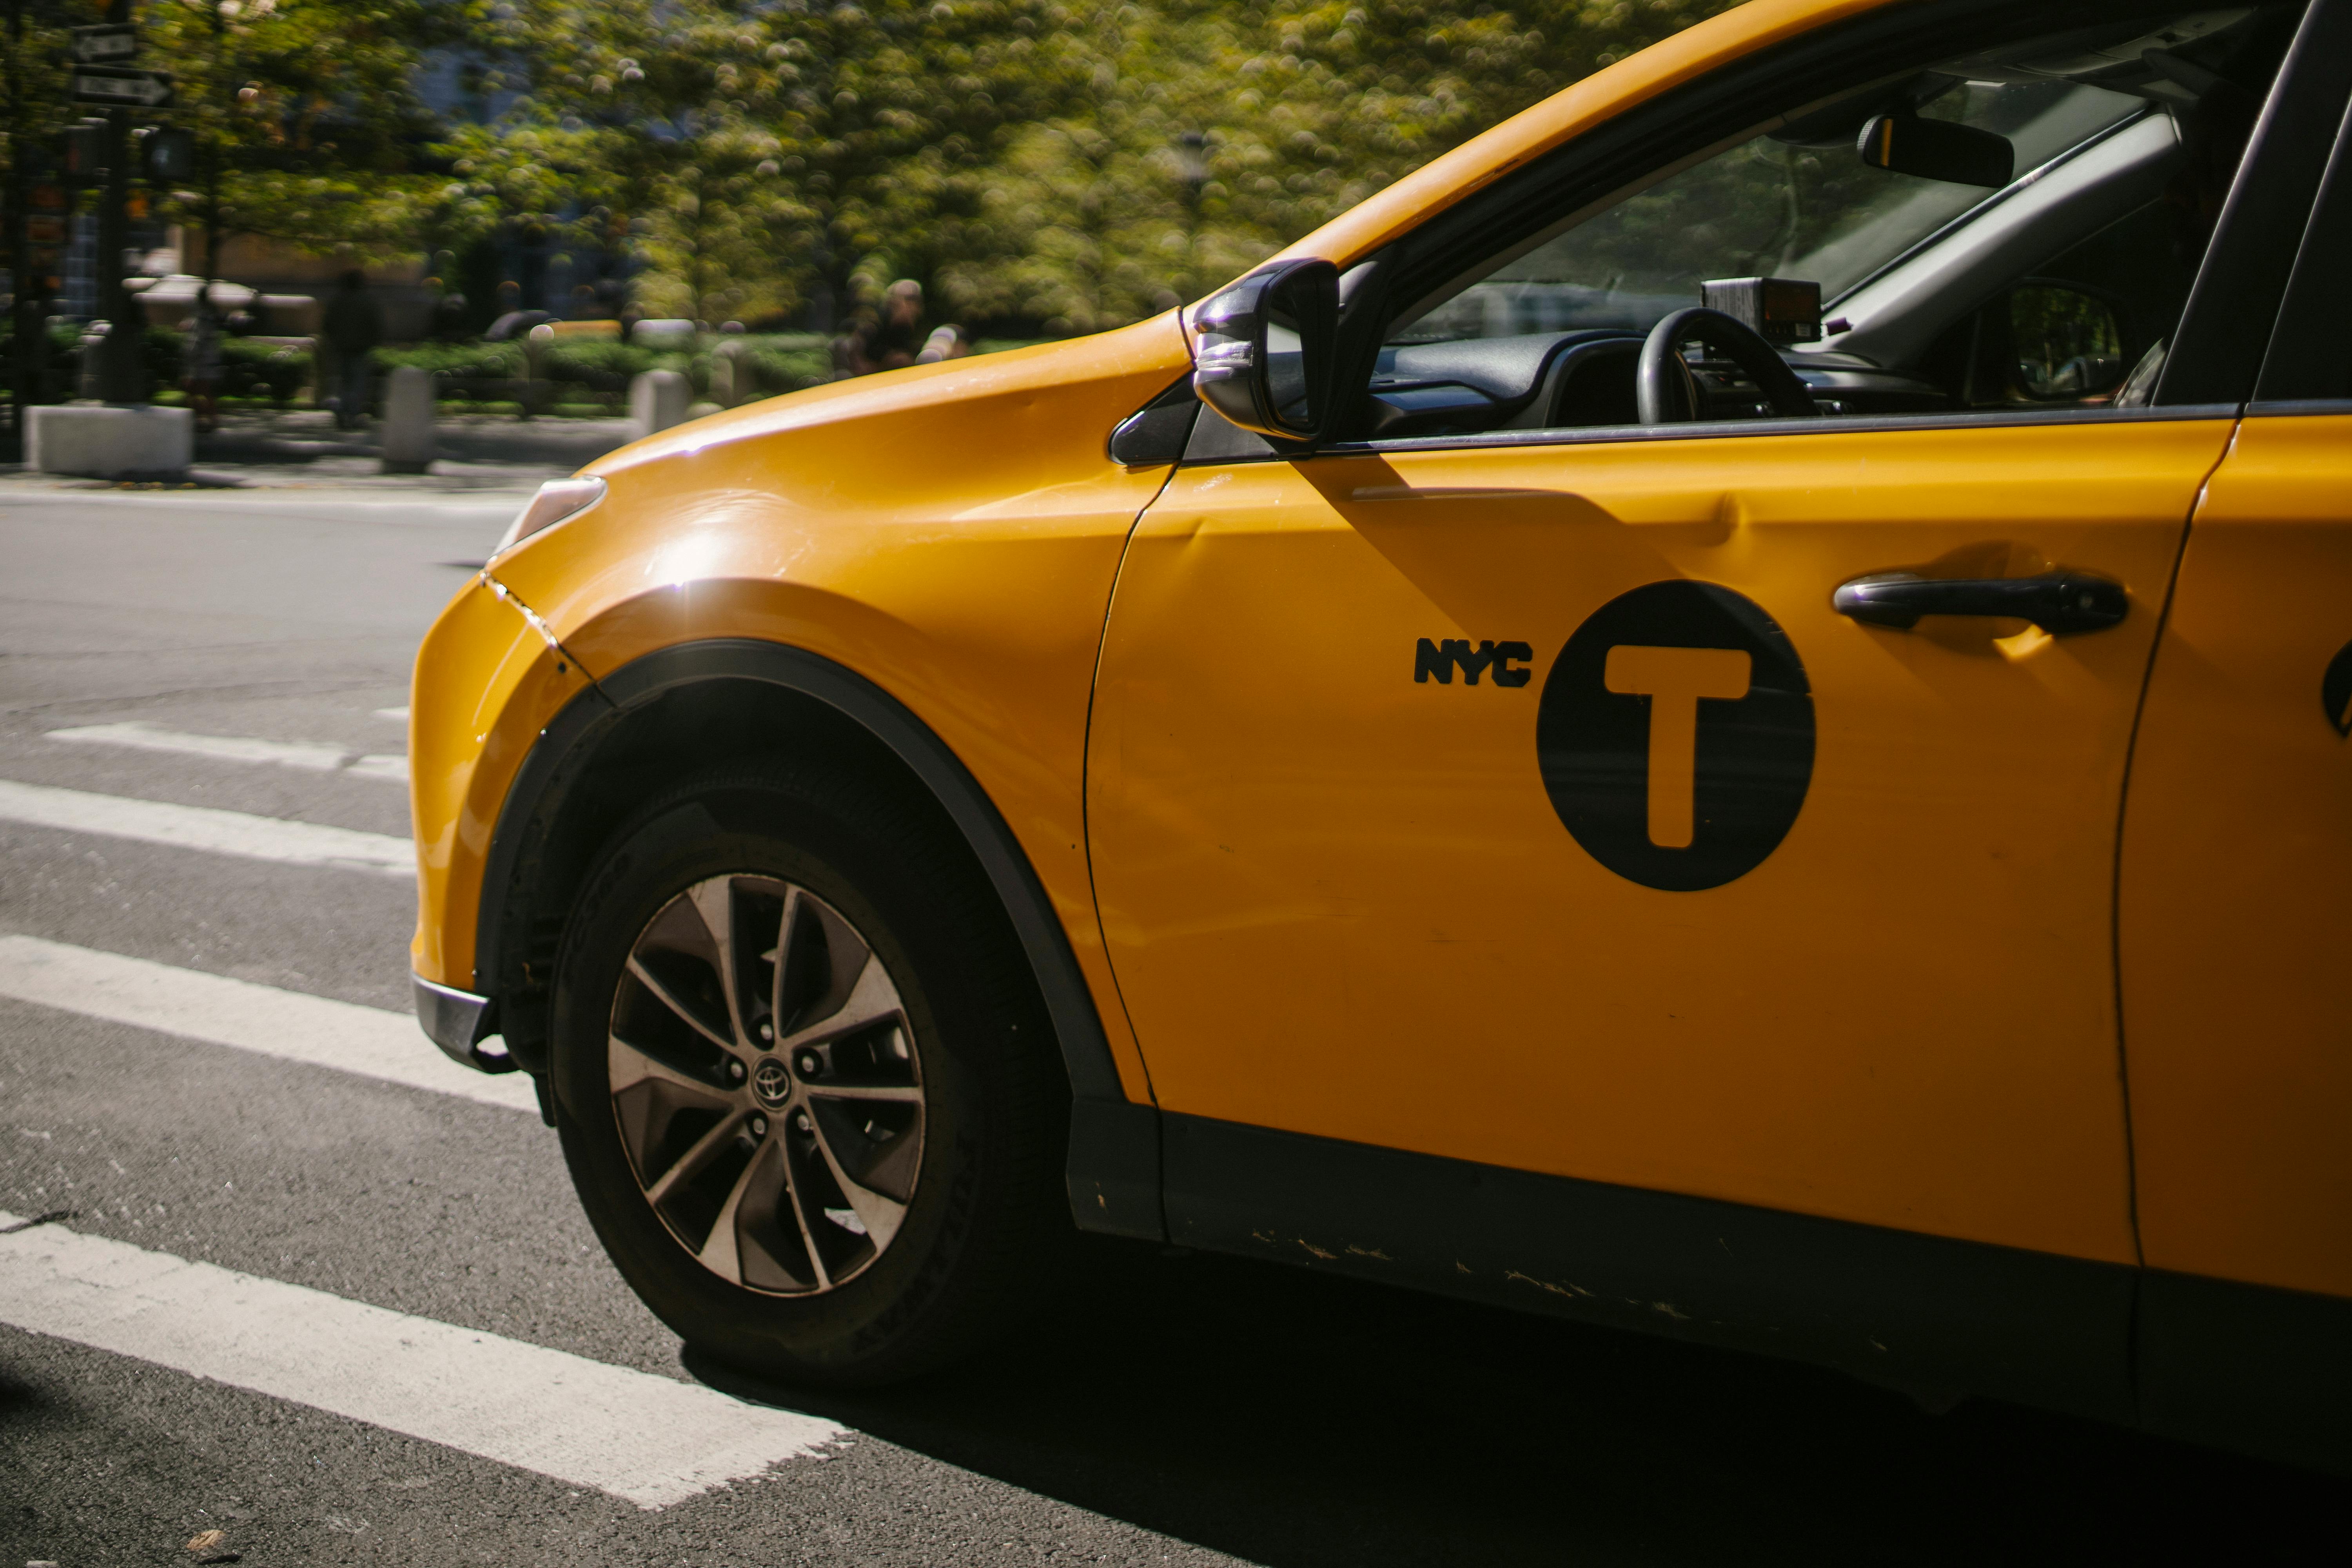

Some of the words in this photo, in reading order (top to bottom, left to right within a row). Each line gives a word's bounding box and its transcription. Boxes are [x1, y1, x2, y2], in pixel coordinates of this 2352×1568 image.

[1414, 637, 1533, 688] NYC
[1604, 644, 1752, 848] T
[850, 1130, 978, 1355] FULLWAY
